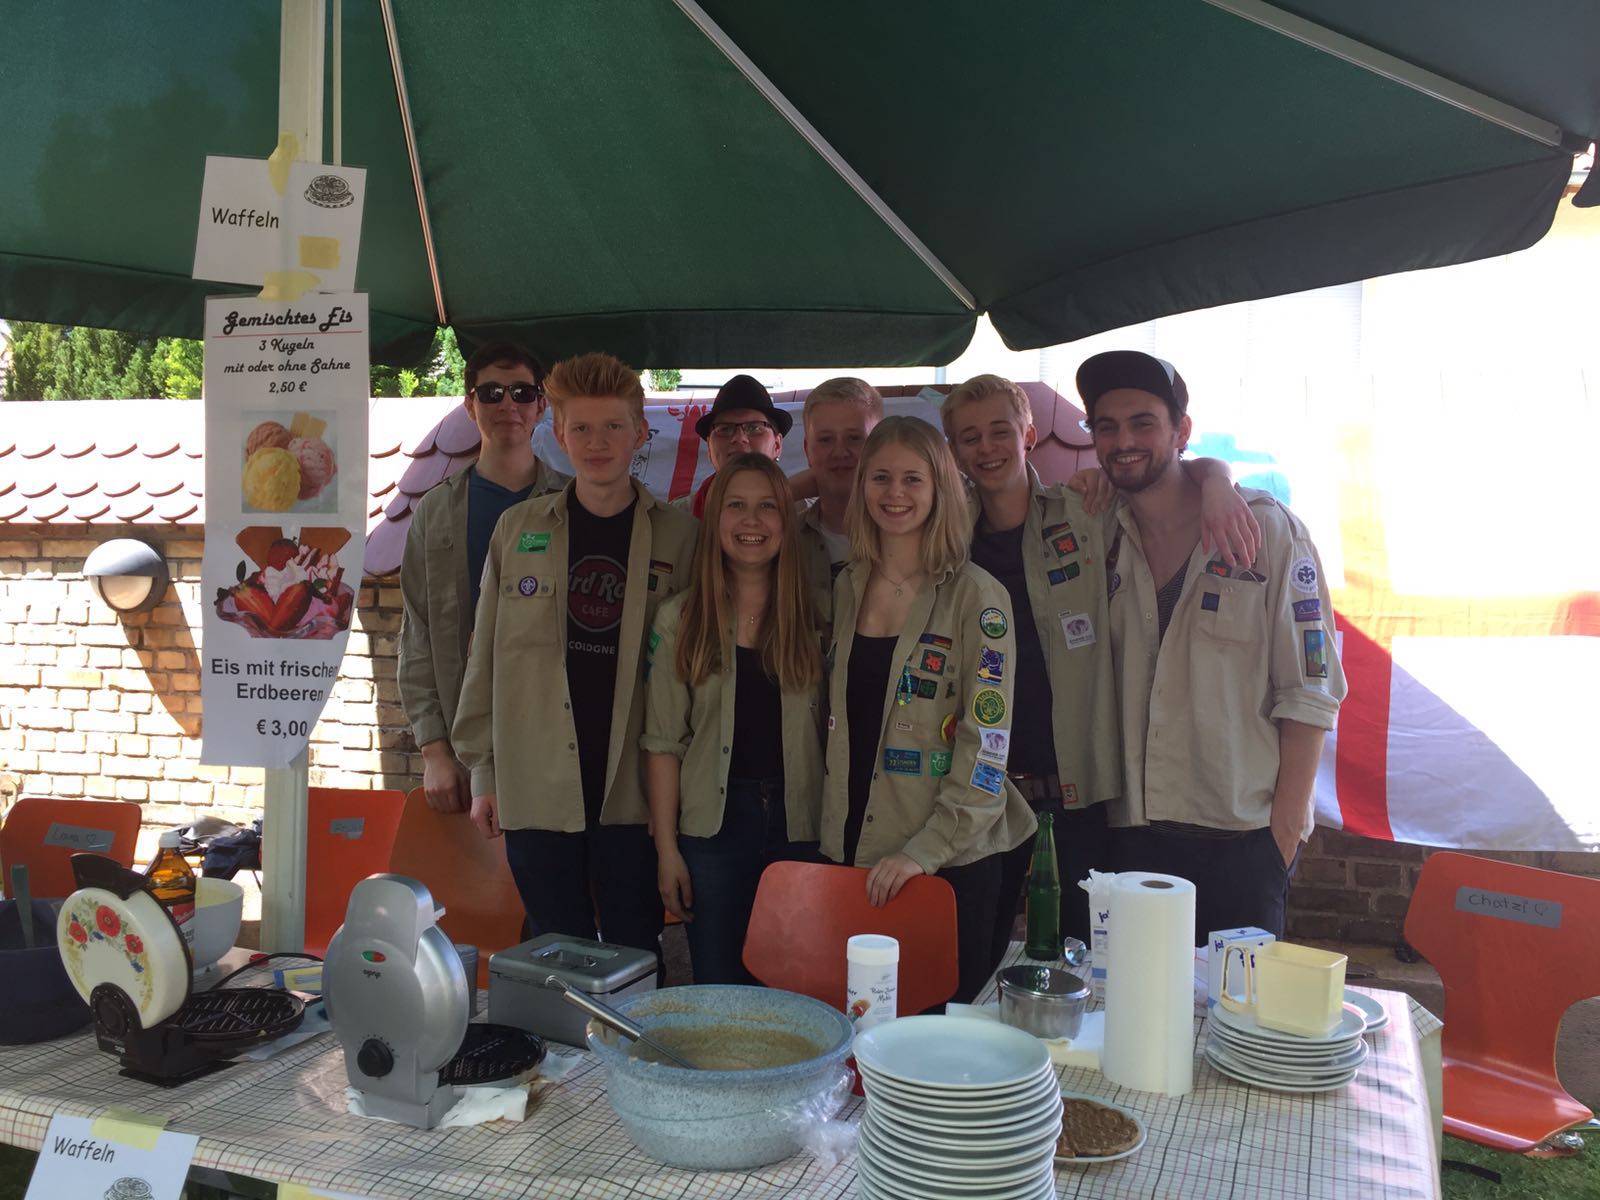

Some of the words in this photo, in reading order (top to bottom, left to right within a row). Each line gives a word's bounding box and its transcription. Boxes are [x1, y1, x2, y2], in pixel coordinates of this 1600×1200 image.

[212, 207, 280, 229] Waffeln
[222, 309, 317, 335] Gemischtes
[319, 307, 353, 332] Eis
[259, 339, 267, 351] 3
[270, 338, 314, 355] Kugeln
[224, 361, 246, 374] mit
[247, 359, 274, 373] oder
[277, 359, 307, 372] ohne
[310, 358, 351, 373] Sahne
[269, 382, 295, 394] 2,50
[299, 381, 308, 392] €
[568, 640, 616, 655] COLOGNE
[211, 658, 240, 675] Eis
[247, 661, 275, 676] mit
[236, 683, 324, 702] Erdbeeren
[256, 719, 267, 735] €
[271, 720, 308, 739] 3,00
[53, 1136, 116, 1164] Waffeln
